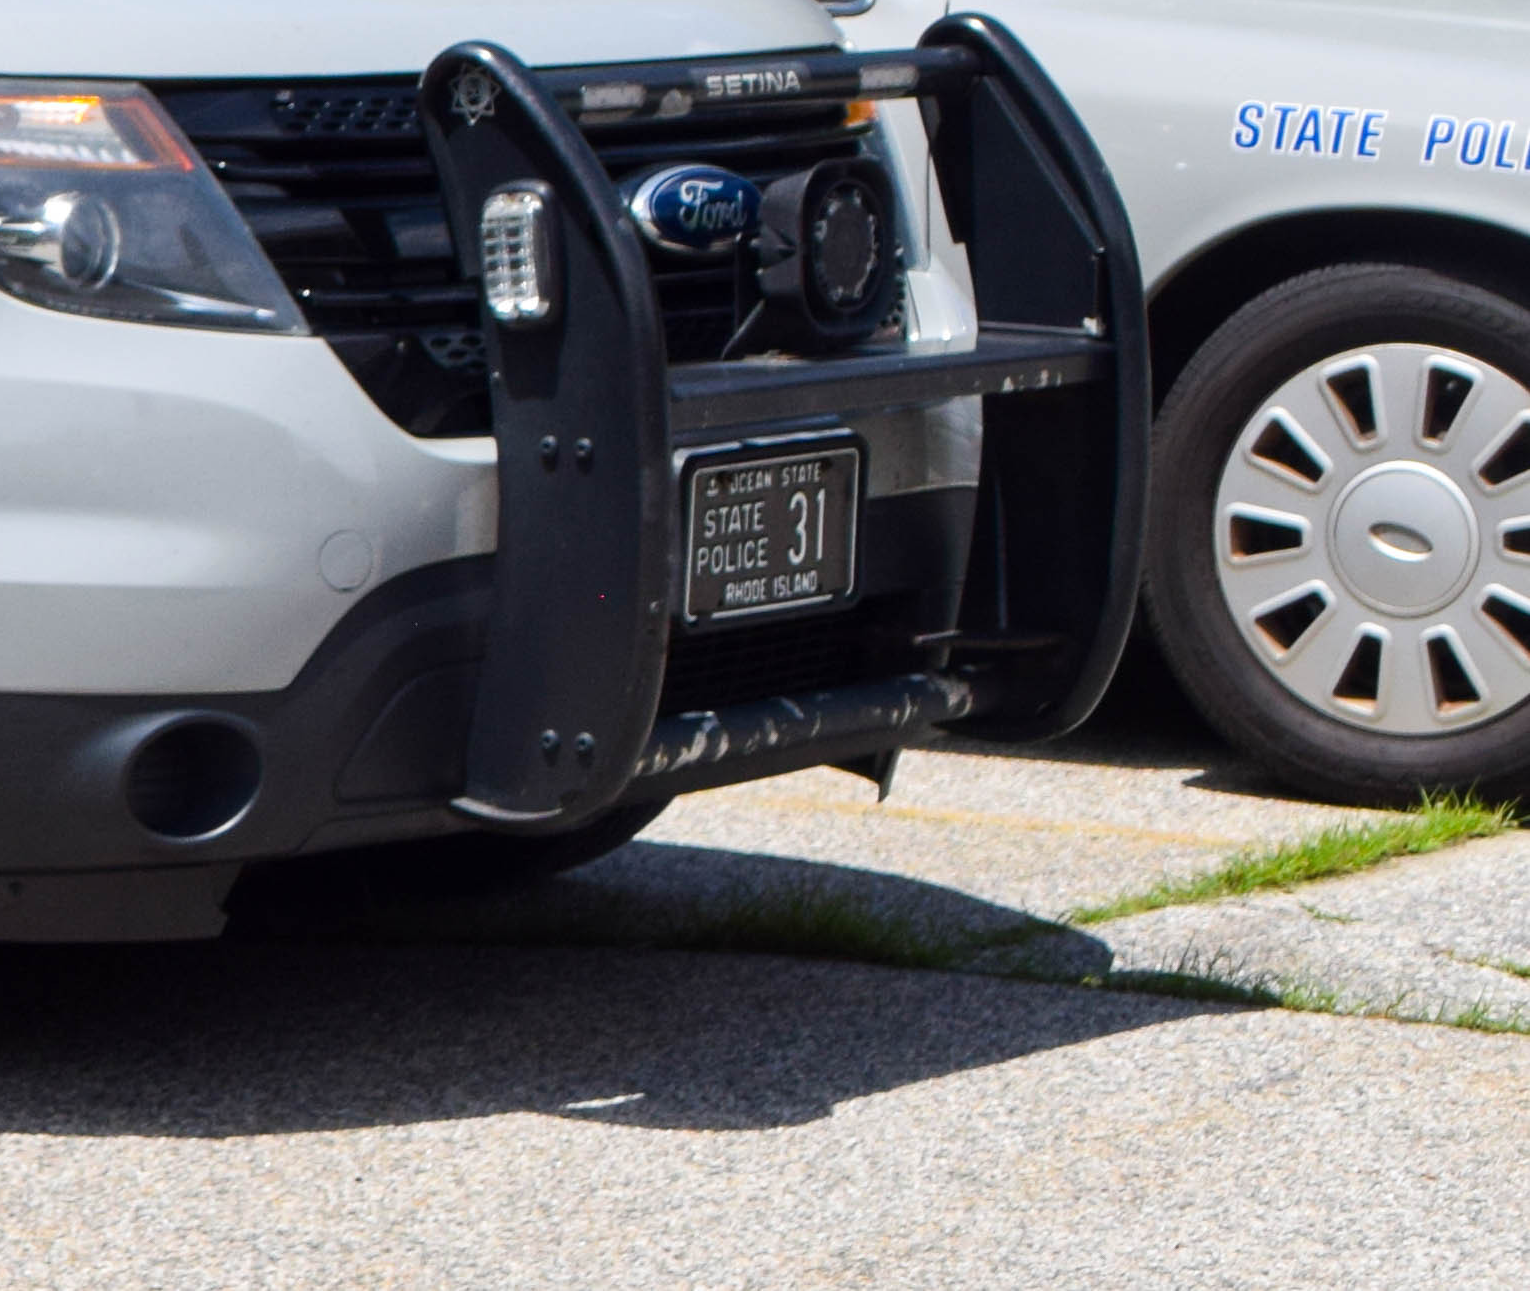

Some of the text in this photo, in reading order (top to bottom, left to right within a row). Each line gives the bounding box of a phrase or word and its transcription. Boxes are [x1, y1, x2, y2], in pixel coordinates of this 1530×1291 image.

[706, 70, 801, 97] SETINA
[1234, 101, 1385, 157] STATE
[679, 179, 748, 230] Ford
[730, 461, 822, 495] OCEAN STATE
[703, 500, 766, 539] STATE
[789, 487, 826, 566] 31
[696, 536, 770, 575] POLICE
[725, 569, 818, 605] RHODE ISLAND
